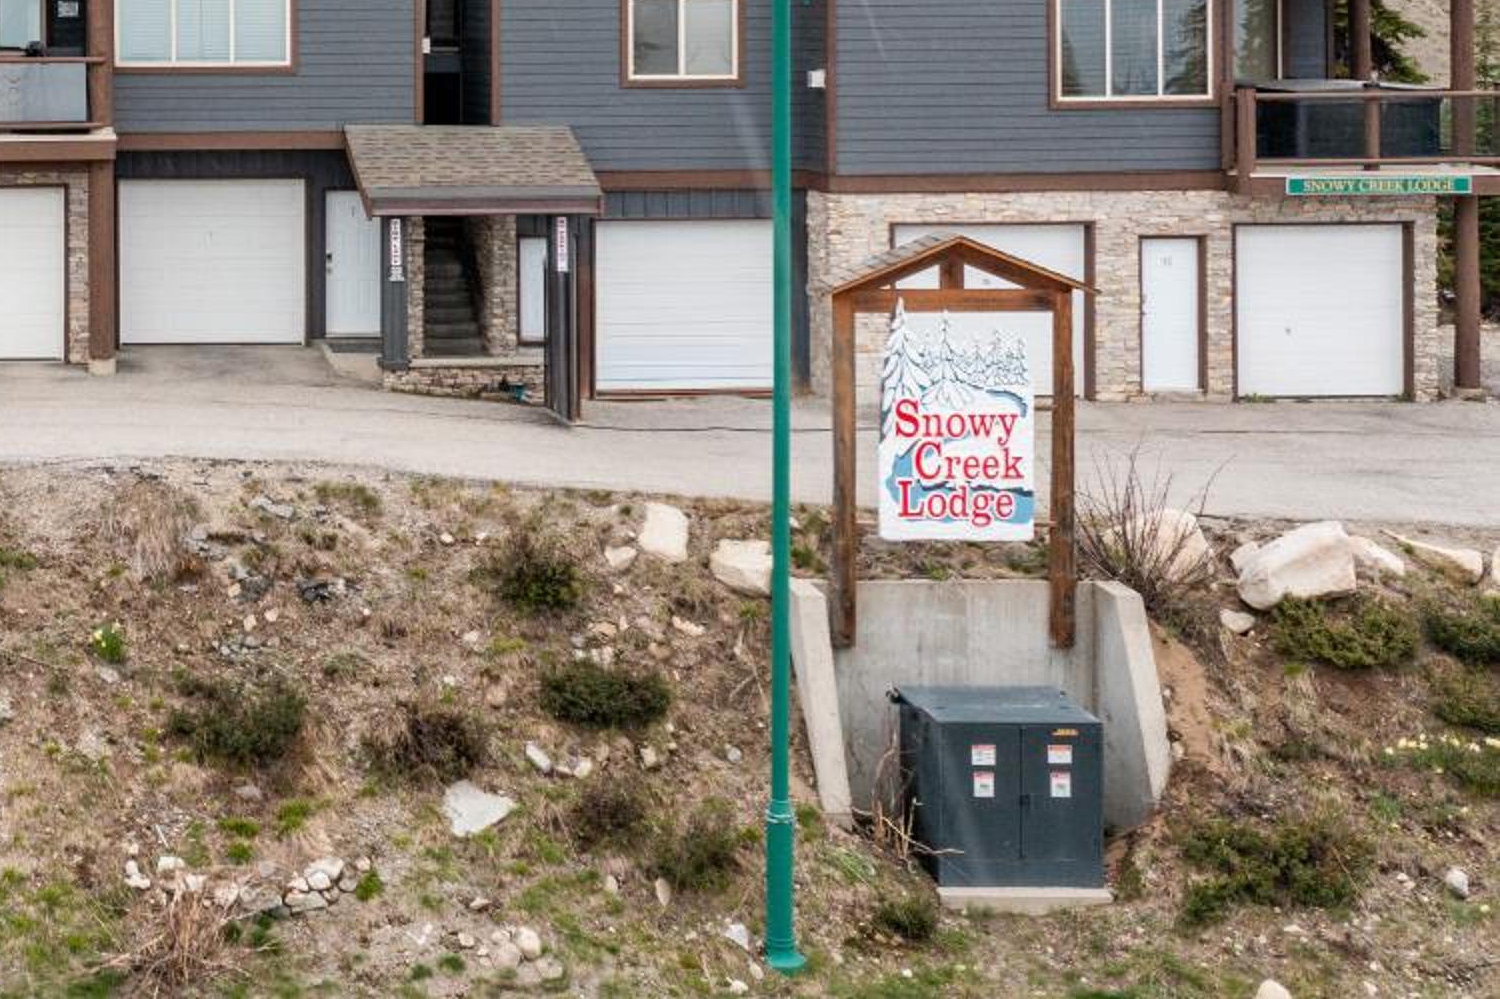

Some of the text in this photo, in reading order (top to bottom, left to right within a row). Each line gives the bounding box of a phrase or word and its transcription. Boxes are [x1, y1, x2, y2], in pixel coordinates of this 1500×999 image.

[1303, 179, 1356, 192] SNOWY
[895, 399, 1018, 445] Snowy
[915, 441, 1024, 480] Creek
[898, 480, 1014, 527] Lodge
